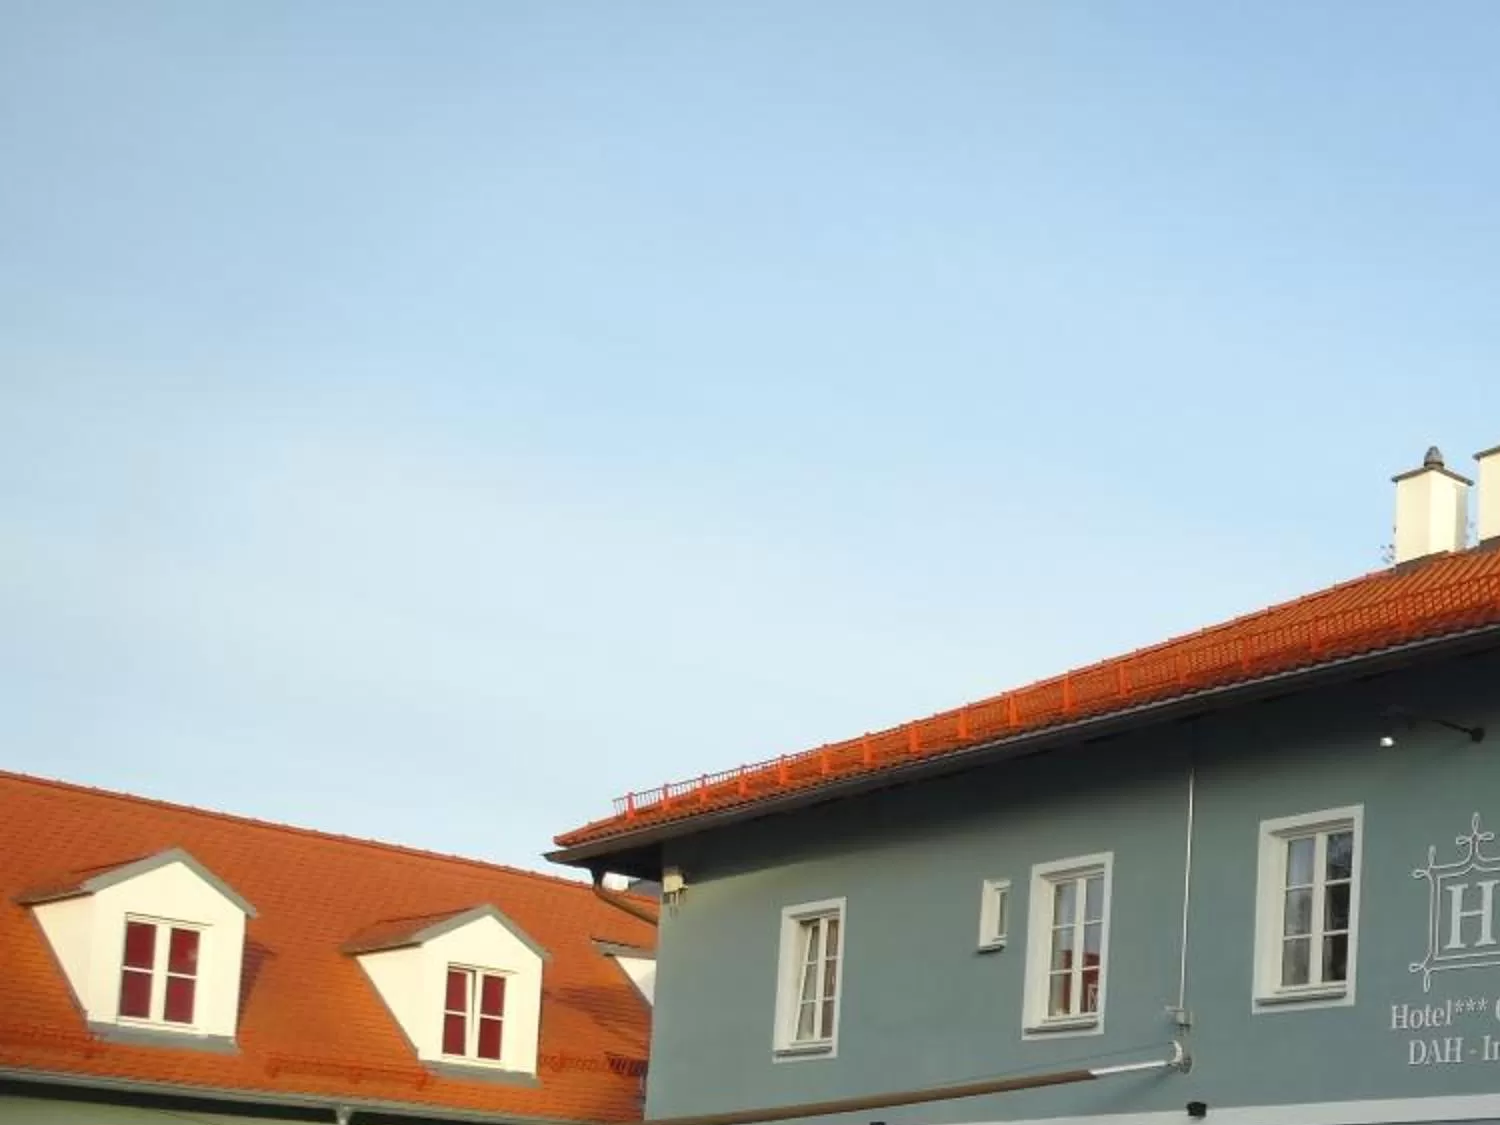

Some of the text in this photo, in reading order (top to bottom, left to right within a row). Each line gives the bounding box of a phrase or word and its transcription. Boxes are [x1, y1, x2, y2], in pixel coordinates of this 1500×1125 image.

[1443, 879, 1500, 950] H
[1390, 999, 1452, 1031] Hotel
[1407, 1036, 1464, 1066] DAH
